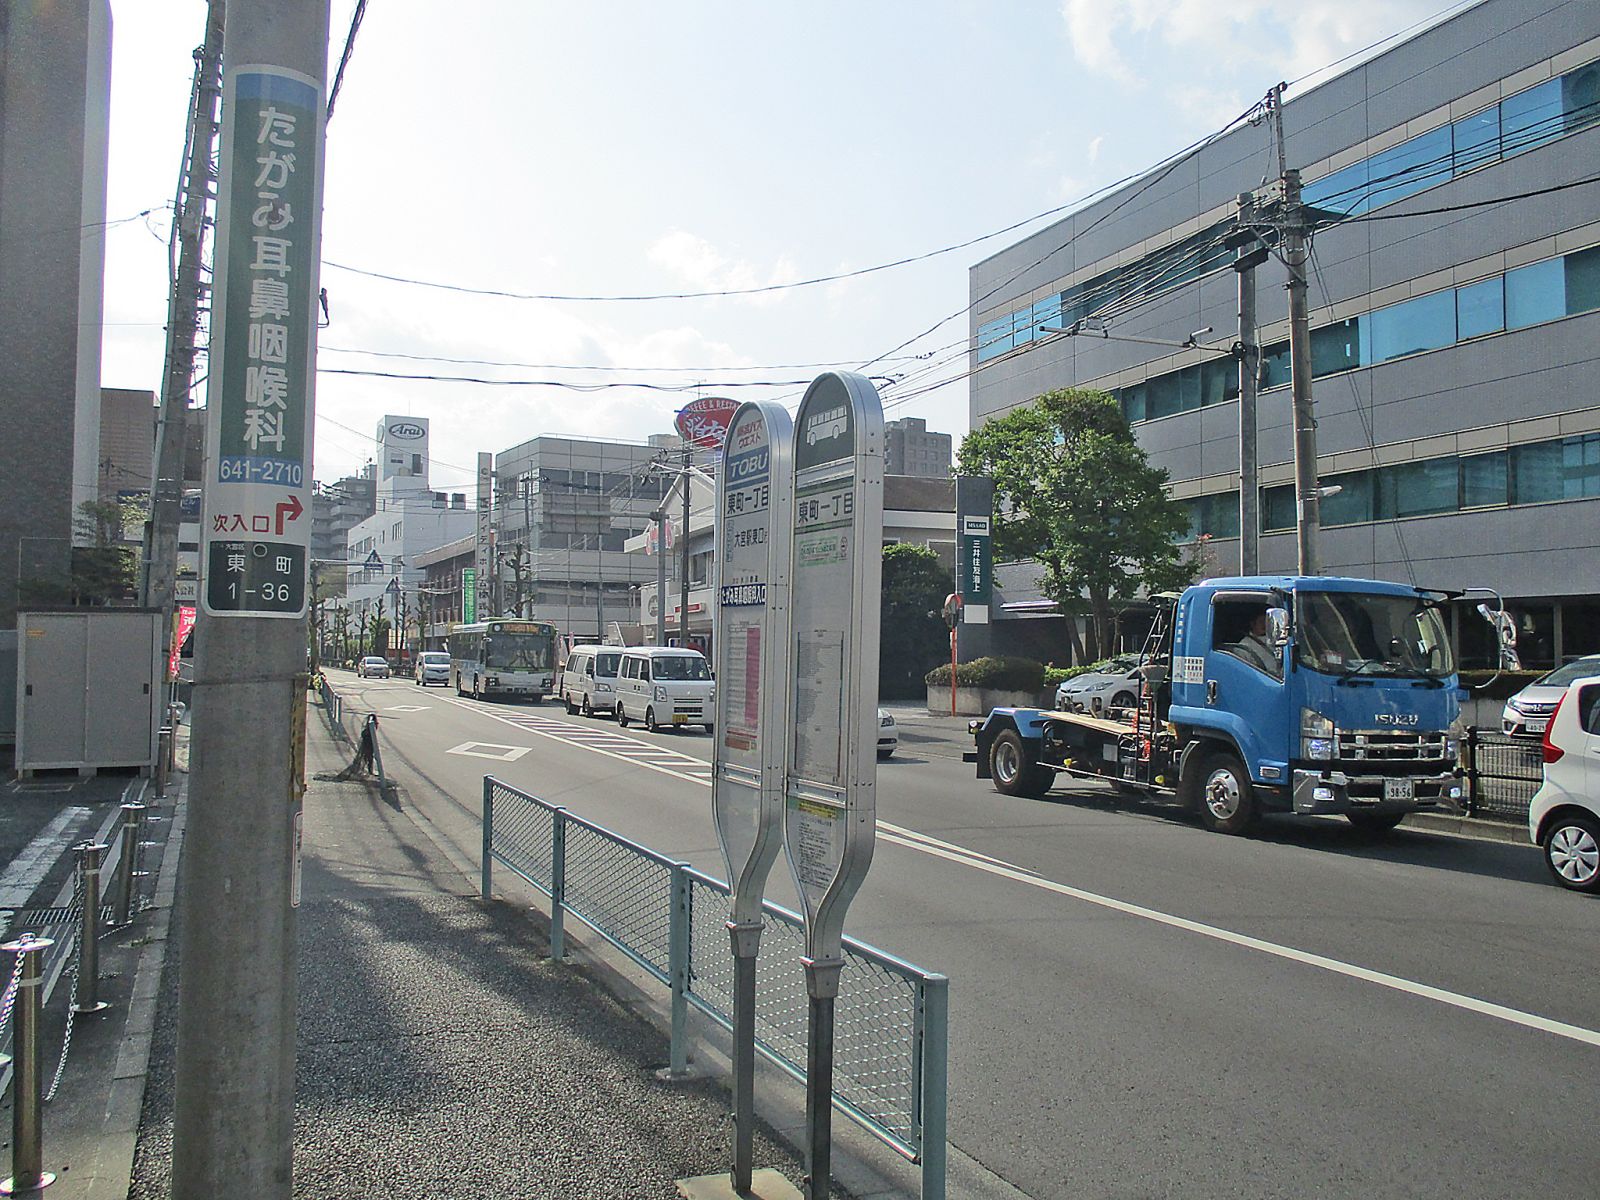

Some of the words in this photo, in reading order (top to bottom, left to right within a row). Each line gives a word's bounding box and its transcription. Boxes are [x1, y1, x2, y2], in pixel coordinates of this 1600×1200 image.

[242, 106, 297, 452] たがみ耳鼻咽喉科
[392, 425, 421, 436] Arai
[219, 460, 302, 485] 641-2710
[731, 452, 768, 478] TOBU
[727, 484, 769, 515] 東町一丁目
[798, 492, 854, 523] 東町一丁目
[213, 514, 270, 533] 次入口
[972, 540, 981, 592] 三井住友海上
[228, 582, 289, 602] 1-36
[1374, 714, 1418, 725] ISUZU
